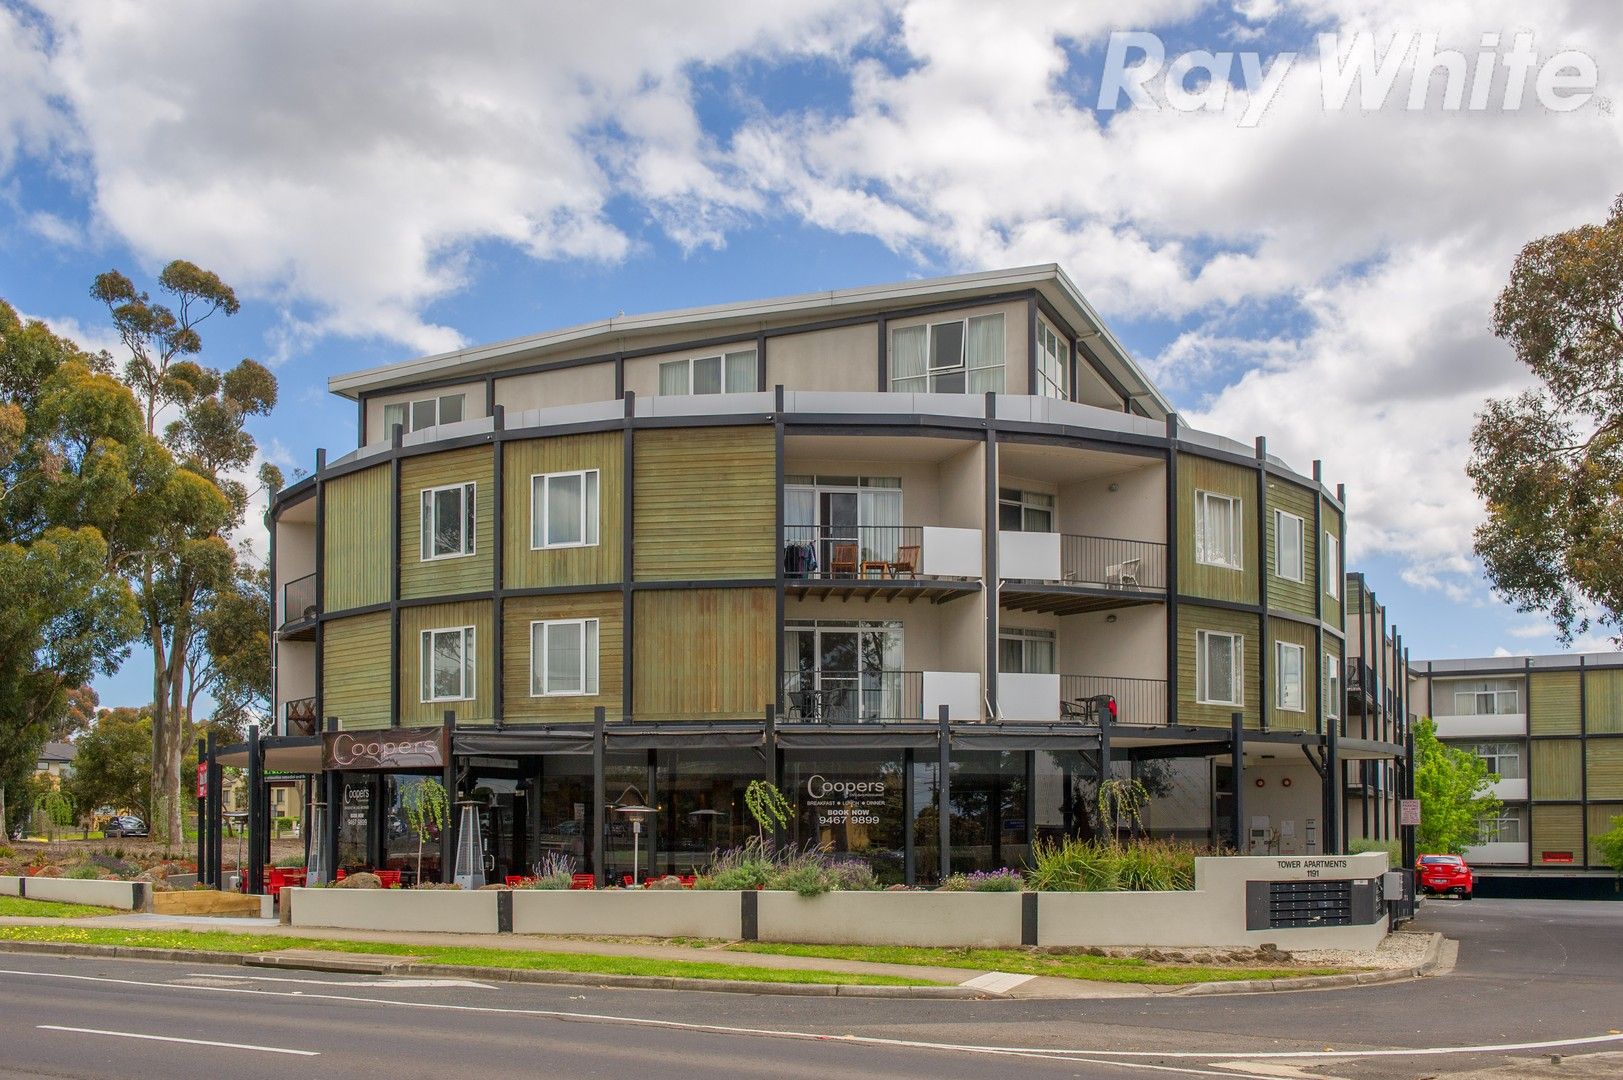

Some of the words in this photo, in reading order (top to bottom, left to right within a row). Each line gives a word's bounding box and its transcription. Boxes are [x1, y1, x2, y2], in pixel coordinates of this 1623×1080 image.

[333, 734, 437, 765] Coopers
[807, 774, 885, 799] Coopers
[344, 784, 370, 804] Coopers
[819, 816, 848, 825] 9467
[851, 816, 880, 825] 9899
[1277, 860, 1301, 869] TOWER
[1303, 860, 1347, 868] APARTMENTS
[1307, 869, 1320, 878] 1191
